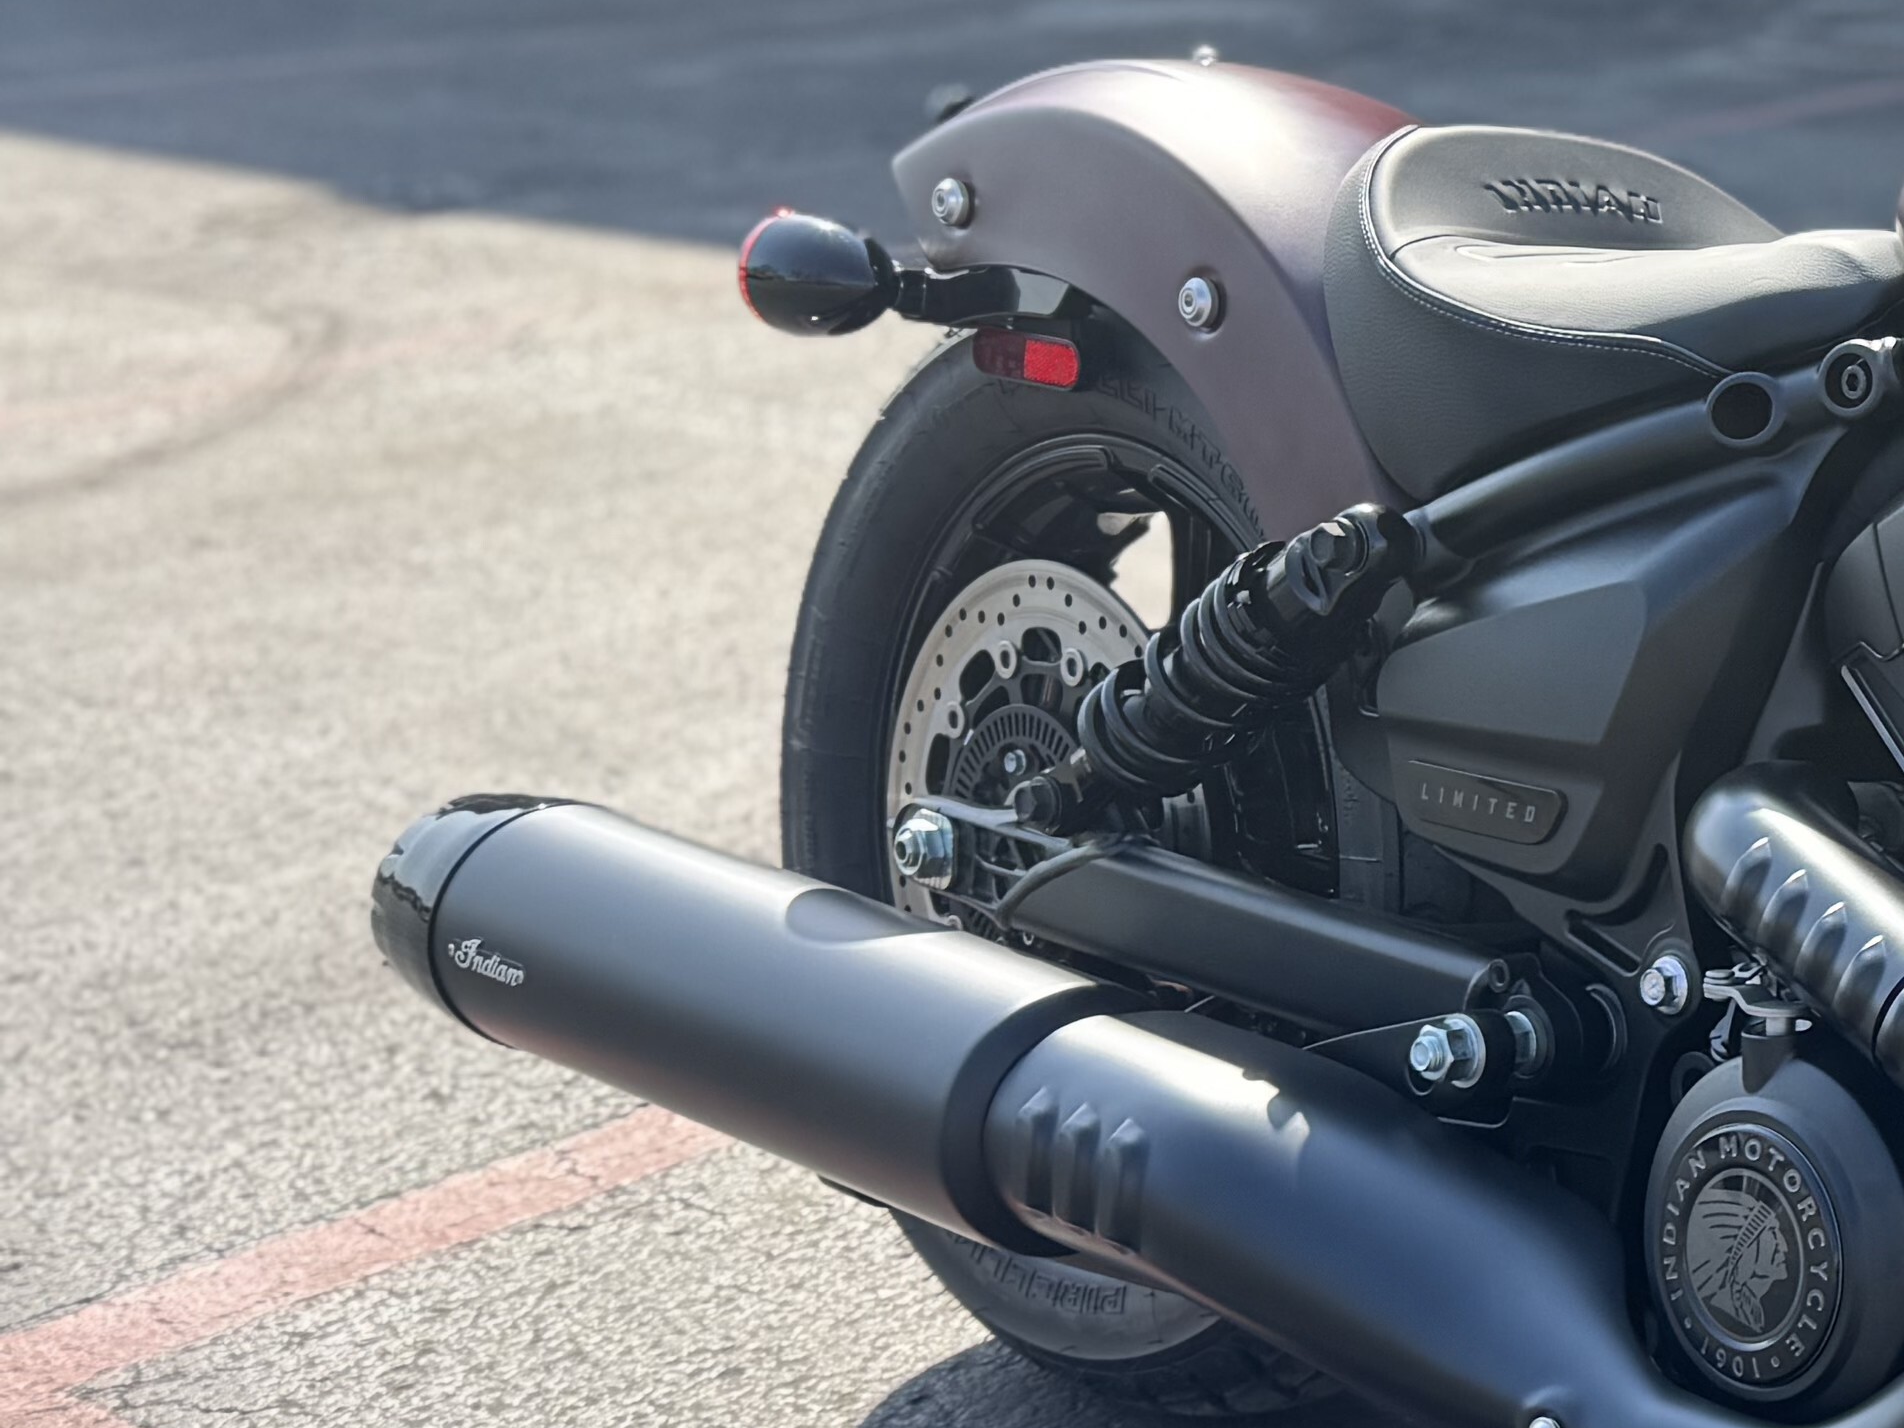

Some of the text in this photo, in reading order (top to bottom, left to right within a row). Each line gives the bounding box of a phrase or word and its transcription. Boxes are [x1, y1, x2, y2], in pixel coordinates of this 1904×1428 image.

[1421, 782, 1536, 822] LIMITED
[454, 938, 524, 987] Indian
[1662, 1134, 1828, 1358] INDIAN MOTORCYCLE
[1700, 1335, 1760, 1379] 1901
